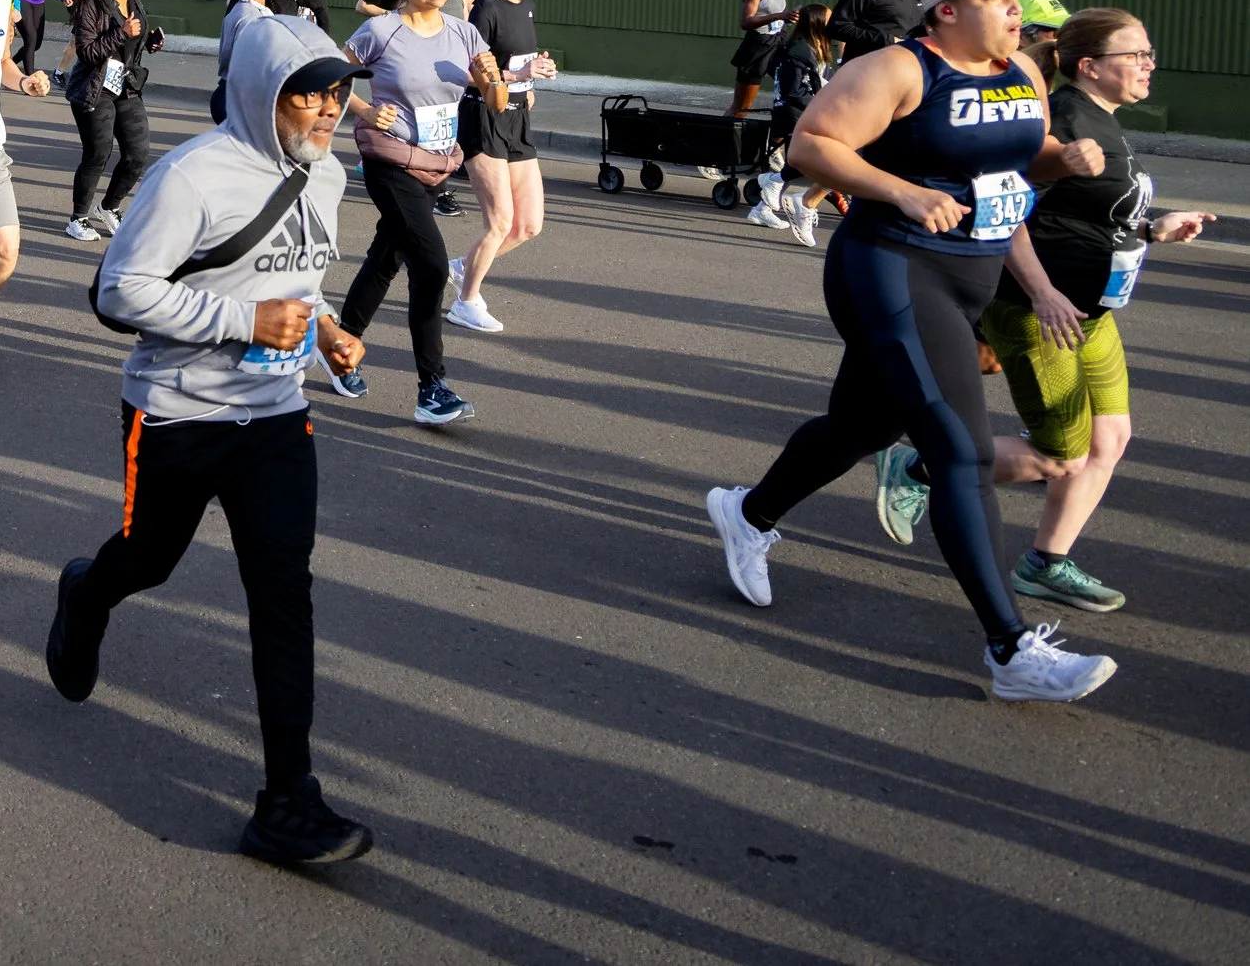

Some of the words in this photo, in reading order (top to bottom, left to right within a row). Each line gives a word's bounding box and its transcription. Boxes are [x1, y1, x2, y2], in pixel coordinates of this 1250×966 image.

[981, 88, 1011, 103] ALL
[430, 118, 453, 141] 266
[990, 193, 1027, 226] 342
